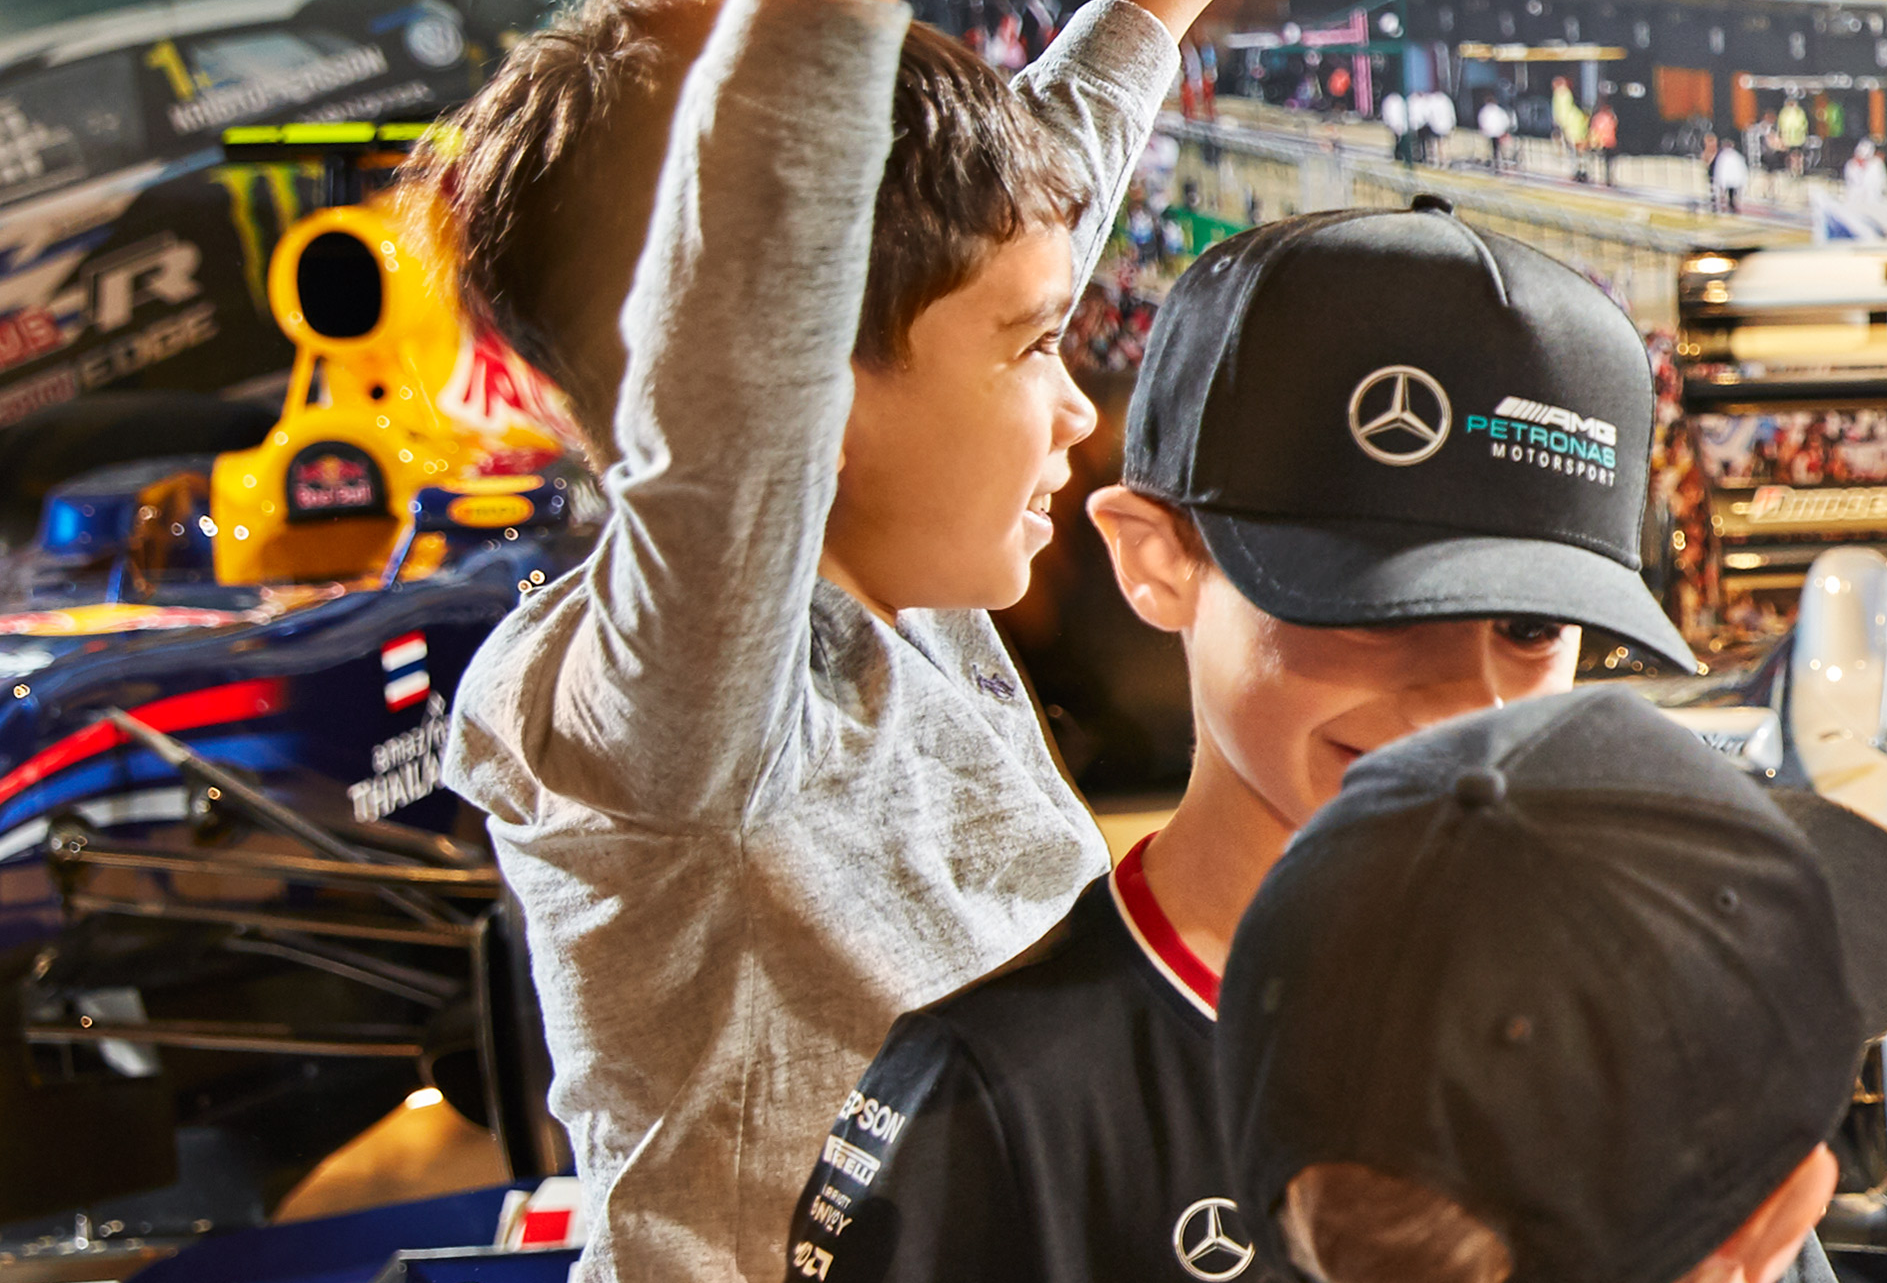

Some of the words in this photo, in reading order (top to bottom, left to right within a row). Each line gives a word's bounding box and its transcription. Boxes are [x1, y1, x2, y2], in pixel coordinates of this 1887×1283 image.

[1466, 415, 1617, 469] PETRONAS
[1541, 405, 1617, 447] AMG
[1492, 442, 1616, 488] MOTORSPORT
[838, 1089, 906, 1144] EPSON
